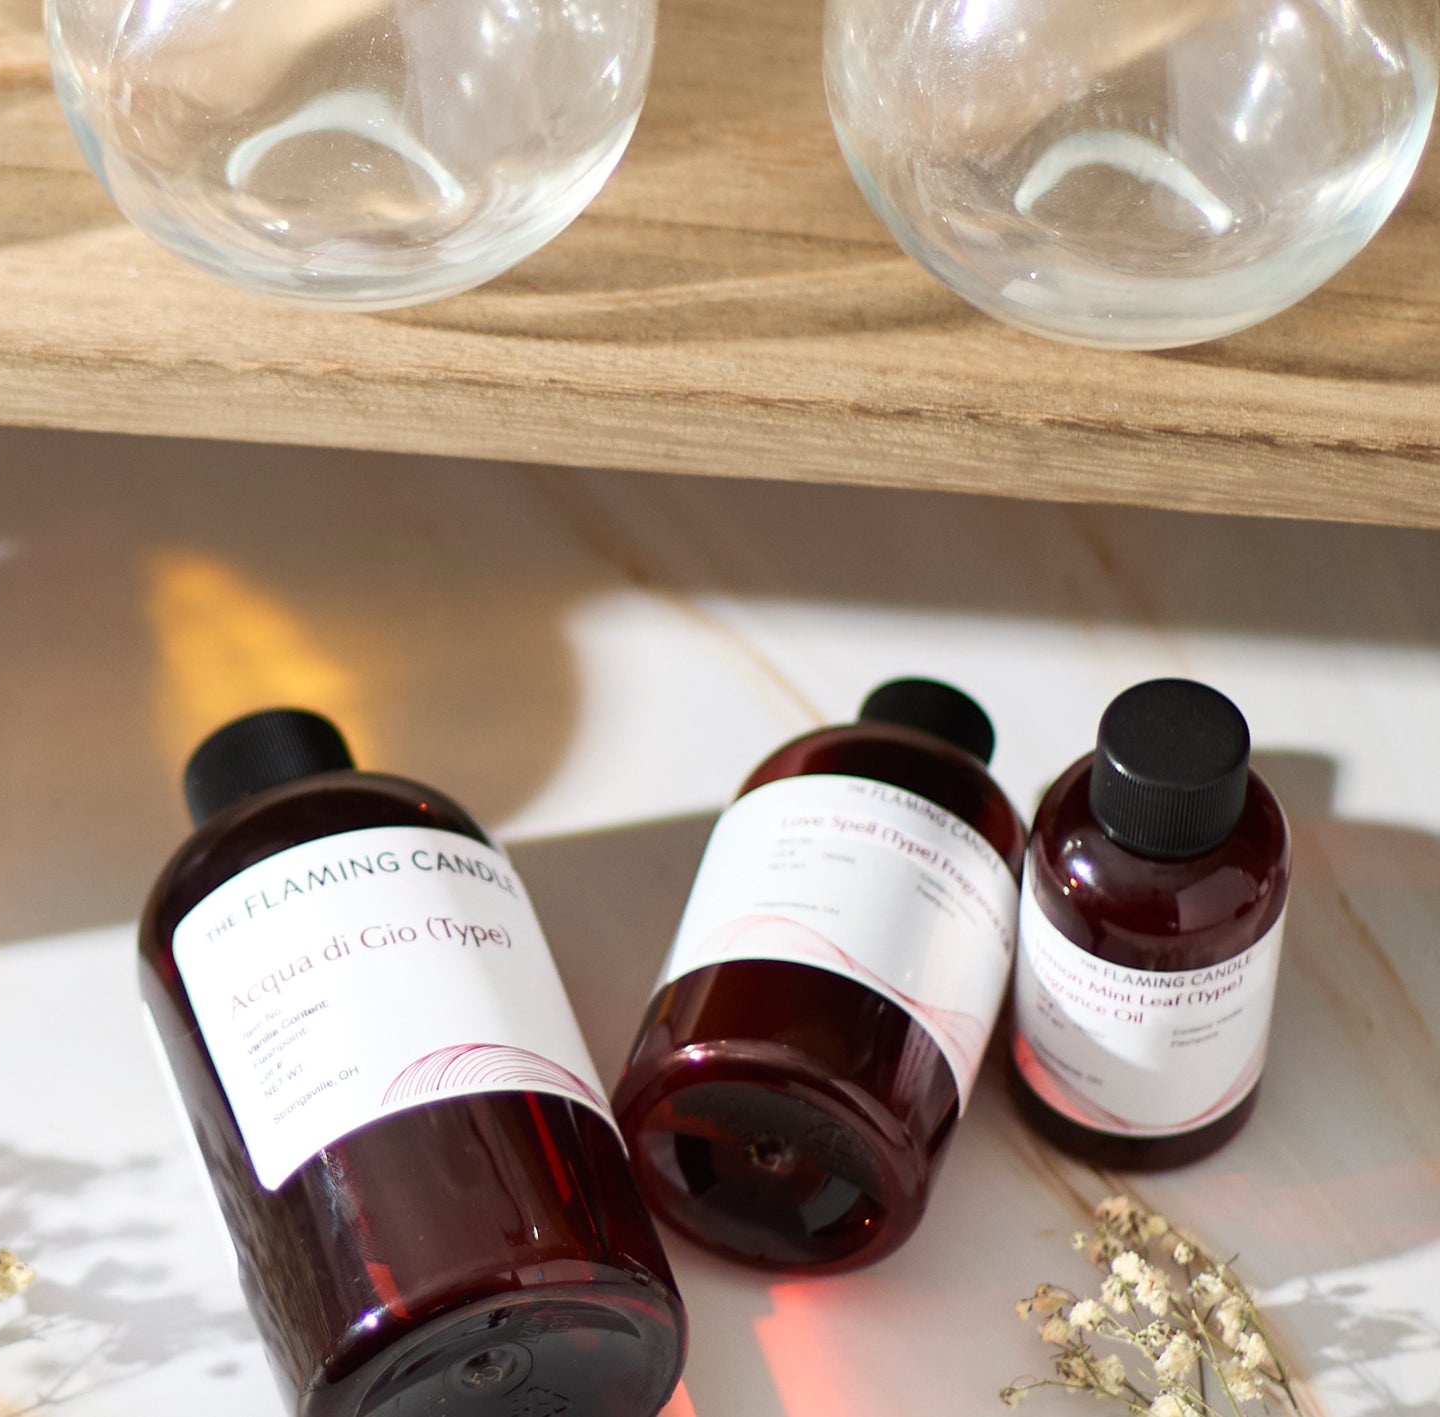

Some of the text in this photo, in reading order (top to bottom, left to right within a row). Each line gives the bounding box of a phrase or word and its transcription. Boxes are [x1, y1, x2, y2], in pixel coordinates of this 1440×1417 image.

[870, 782, 949, 828] FLAMING
[830, 814, 877, 836] Spell
[881, 826, 939, 865] (Type)
[205, 849, 519, 944] THE FLAMING CANDLE
[231, 916, 513, 1020] Acqua di Gio (Type)
[1103, 966, 1187, 989] FLAMING
[1190, 952, 1253, 987] CANDLE
[1088, 980, 1133, 1005] Mint
[1139, 992, 1180, 1008] Leaf
[1187, 973, 1245, 1005] (Type)
[1113, 1009, 1145, 1026] Oil
[264, 1077, 284, 1099] NET
[338, 1065, 360, 1081] OH
